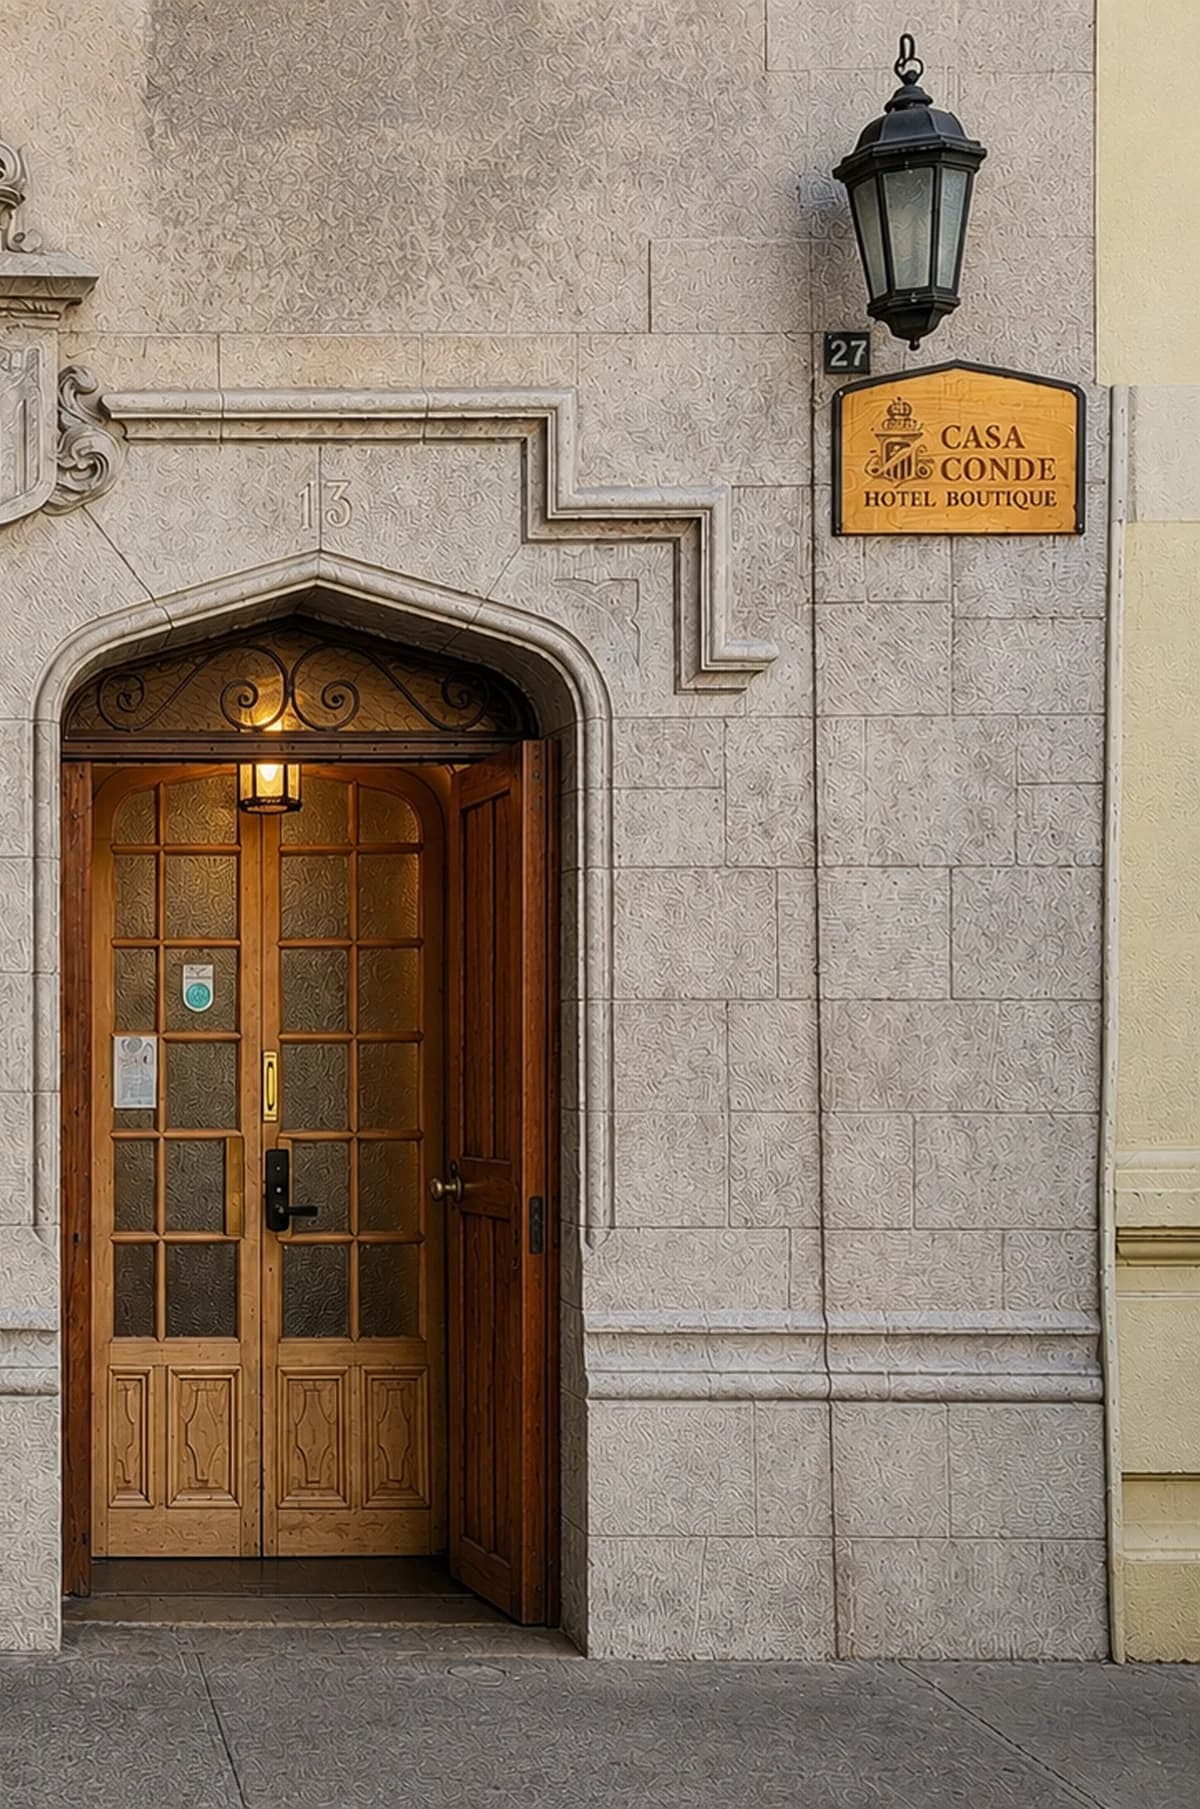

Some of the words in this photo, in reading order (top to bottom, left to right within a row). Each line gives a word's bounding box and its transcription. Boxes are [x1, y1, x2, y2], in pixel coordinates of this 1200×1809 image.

[830, 340, 867, 367] 27
[941, 425, 1025, 449] CASA
[941, 457, 1056, 481] CONDE
[296, 480, 352, 531] 13
[864, 491, 936, 507] HOTEL
[946, 490, 1057, 510] BOUTIQUE
